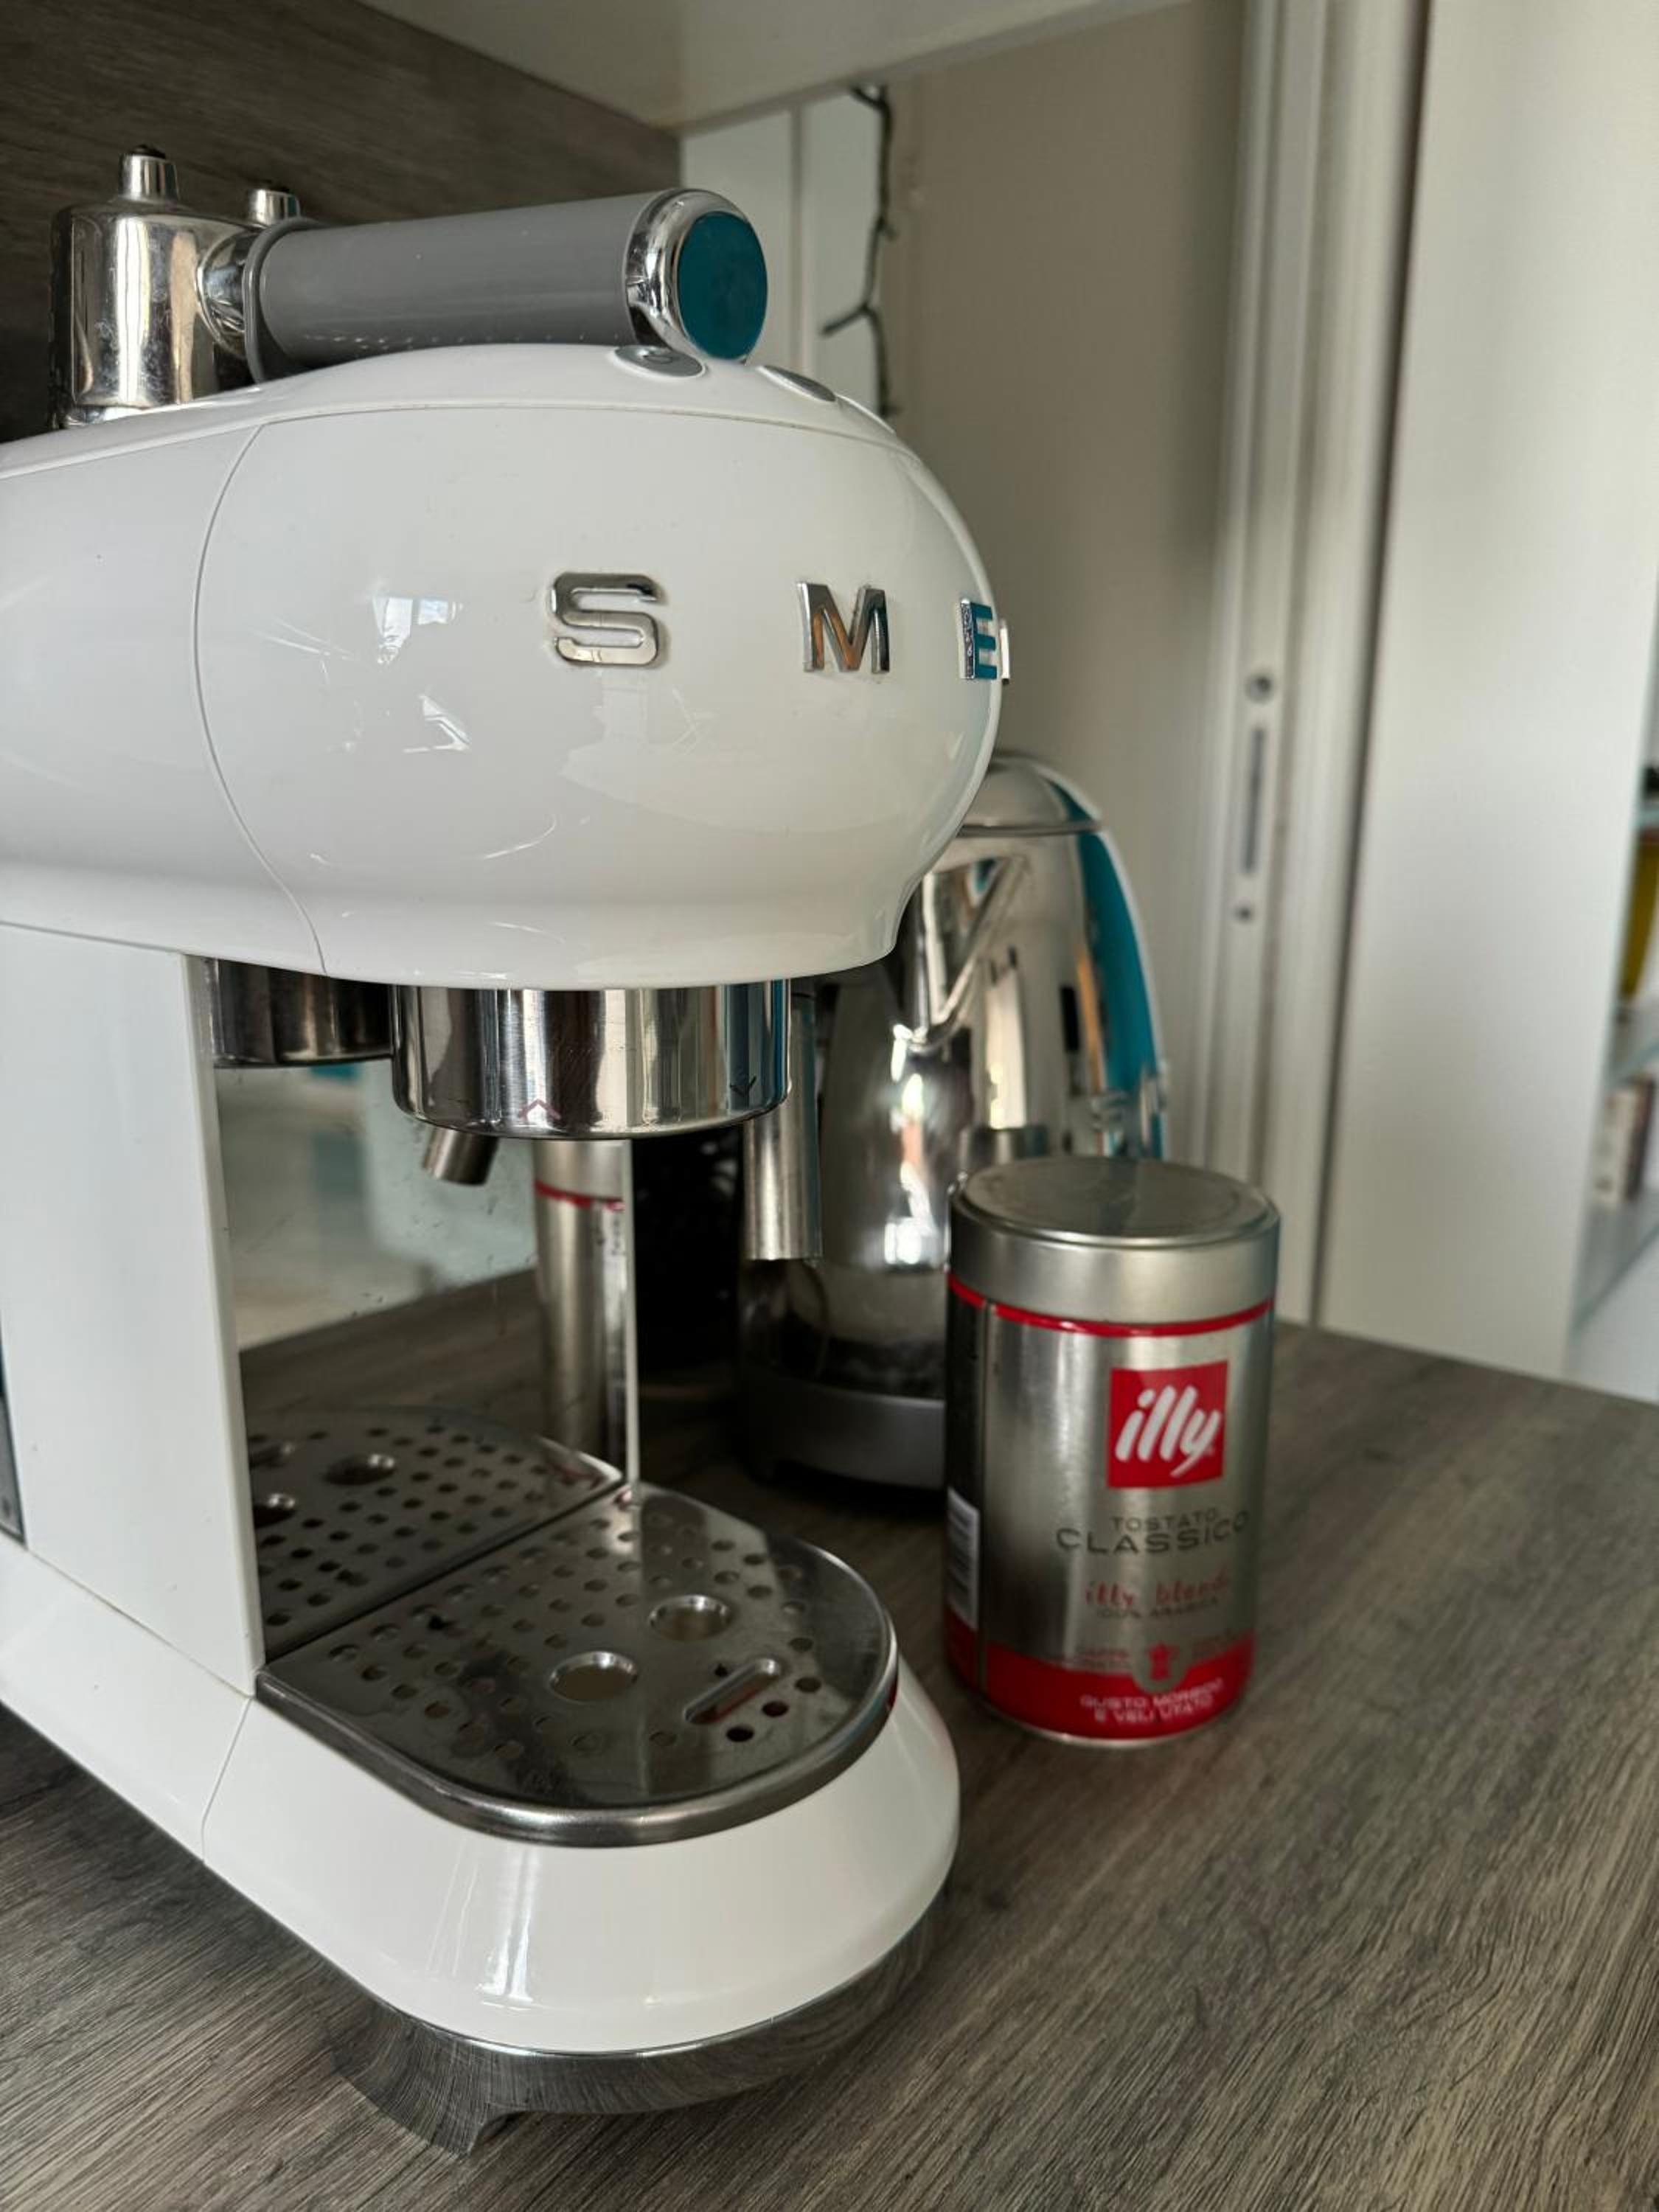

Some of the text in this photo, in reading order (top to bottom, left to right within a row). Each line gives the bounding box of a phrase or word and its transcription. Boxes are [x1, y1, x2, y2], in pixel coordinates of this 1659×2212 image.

[548, 571, 1009, 684] SME
[1114, 1385, 1221, 1478] illy
[1056, 1509, 1248, 1554] CLASSICO
[1111, 1507, 1217, 1532] TOSTATO
